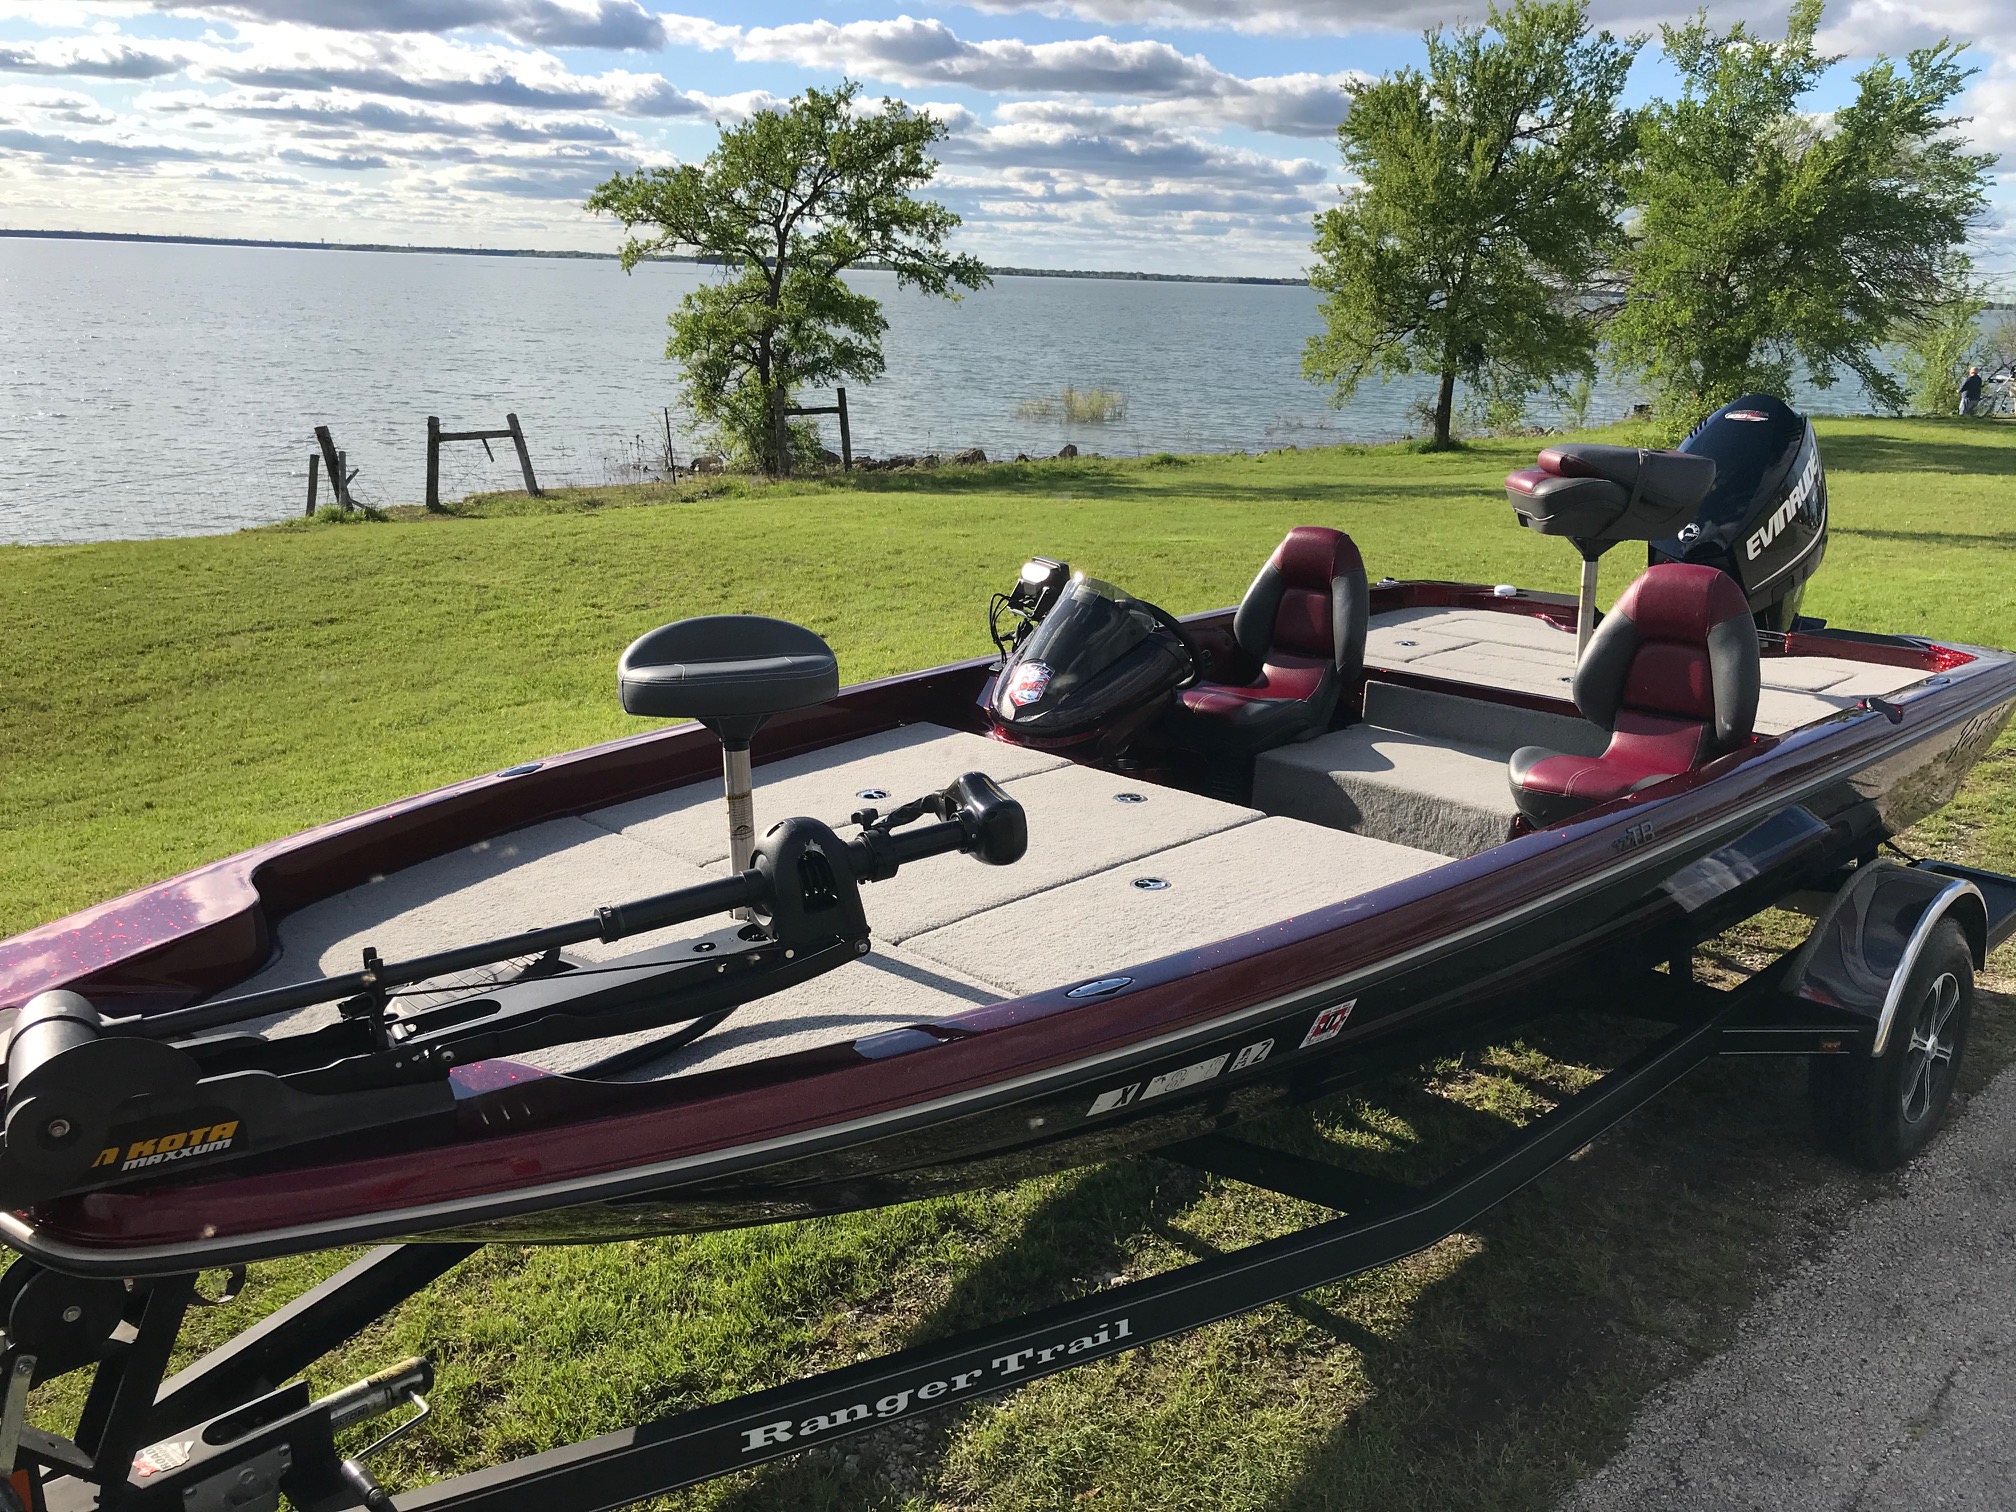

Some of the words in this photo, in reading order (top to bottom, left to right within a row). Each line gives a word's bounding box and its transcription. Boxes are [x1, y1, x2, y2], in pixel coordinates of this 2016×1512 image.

[1746, 446, 1819, 561] EVINRUDE
[120, 1138, 233, 1172] MAXXUM
[126, 1120, 240, 1161] KOTA
[740, 1367, 983, 1453] Ranger
[991, 1317, 1133, 1377] Trail
[145, 1448, 172, 1470] ROAD
